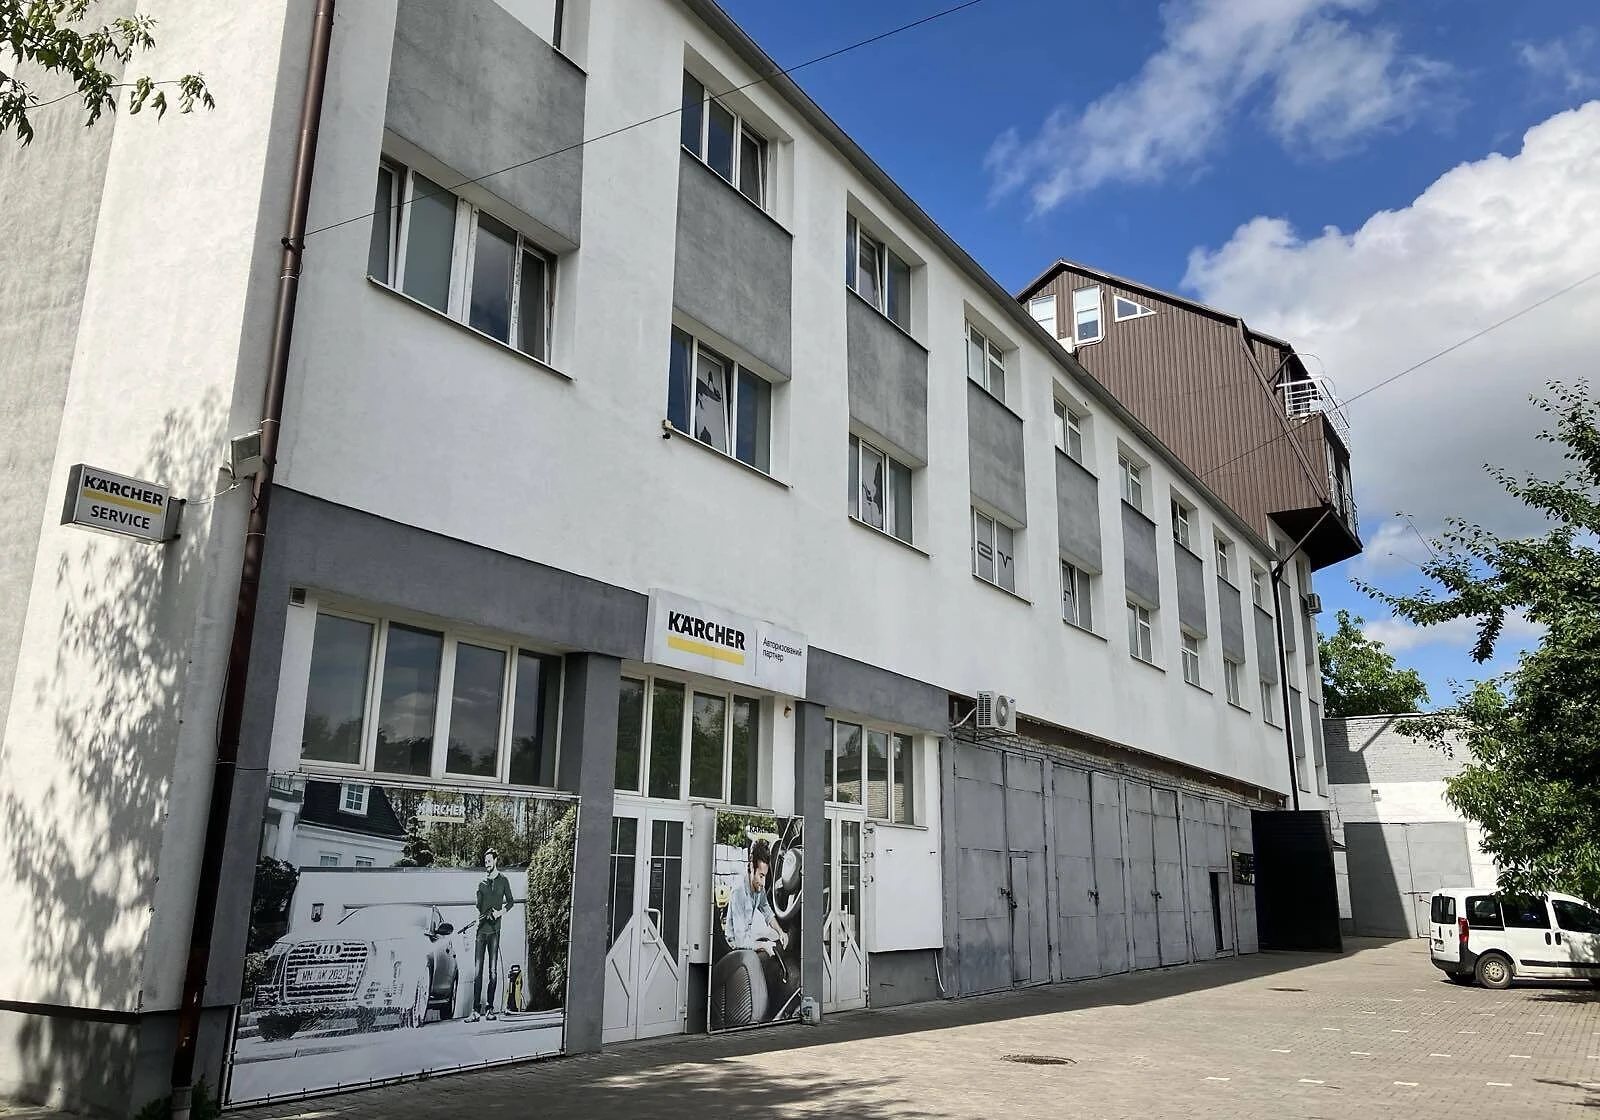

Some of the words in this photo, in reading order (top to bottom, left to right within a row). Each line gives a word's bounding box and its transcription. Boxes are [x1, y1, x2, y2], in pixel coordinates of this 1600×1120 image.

[84, 475, 163, 506] KÄRCHER
[90, 505, 150, 530] SERVICE
[668, 610, 746, 650] KÄRCHER
